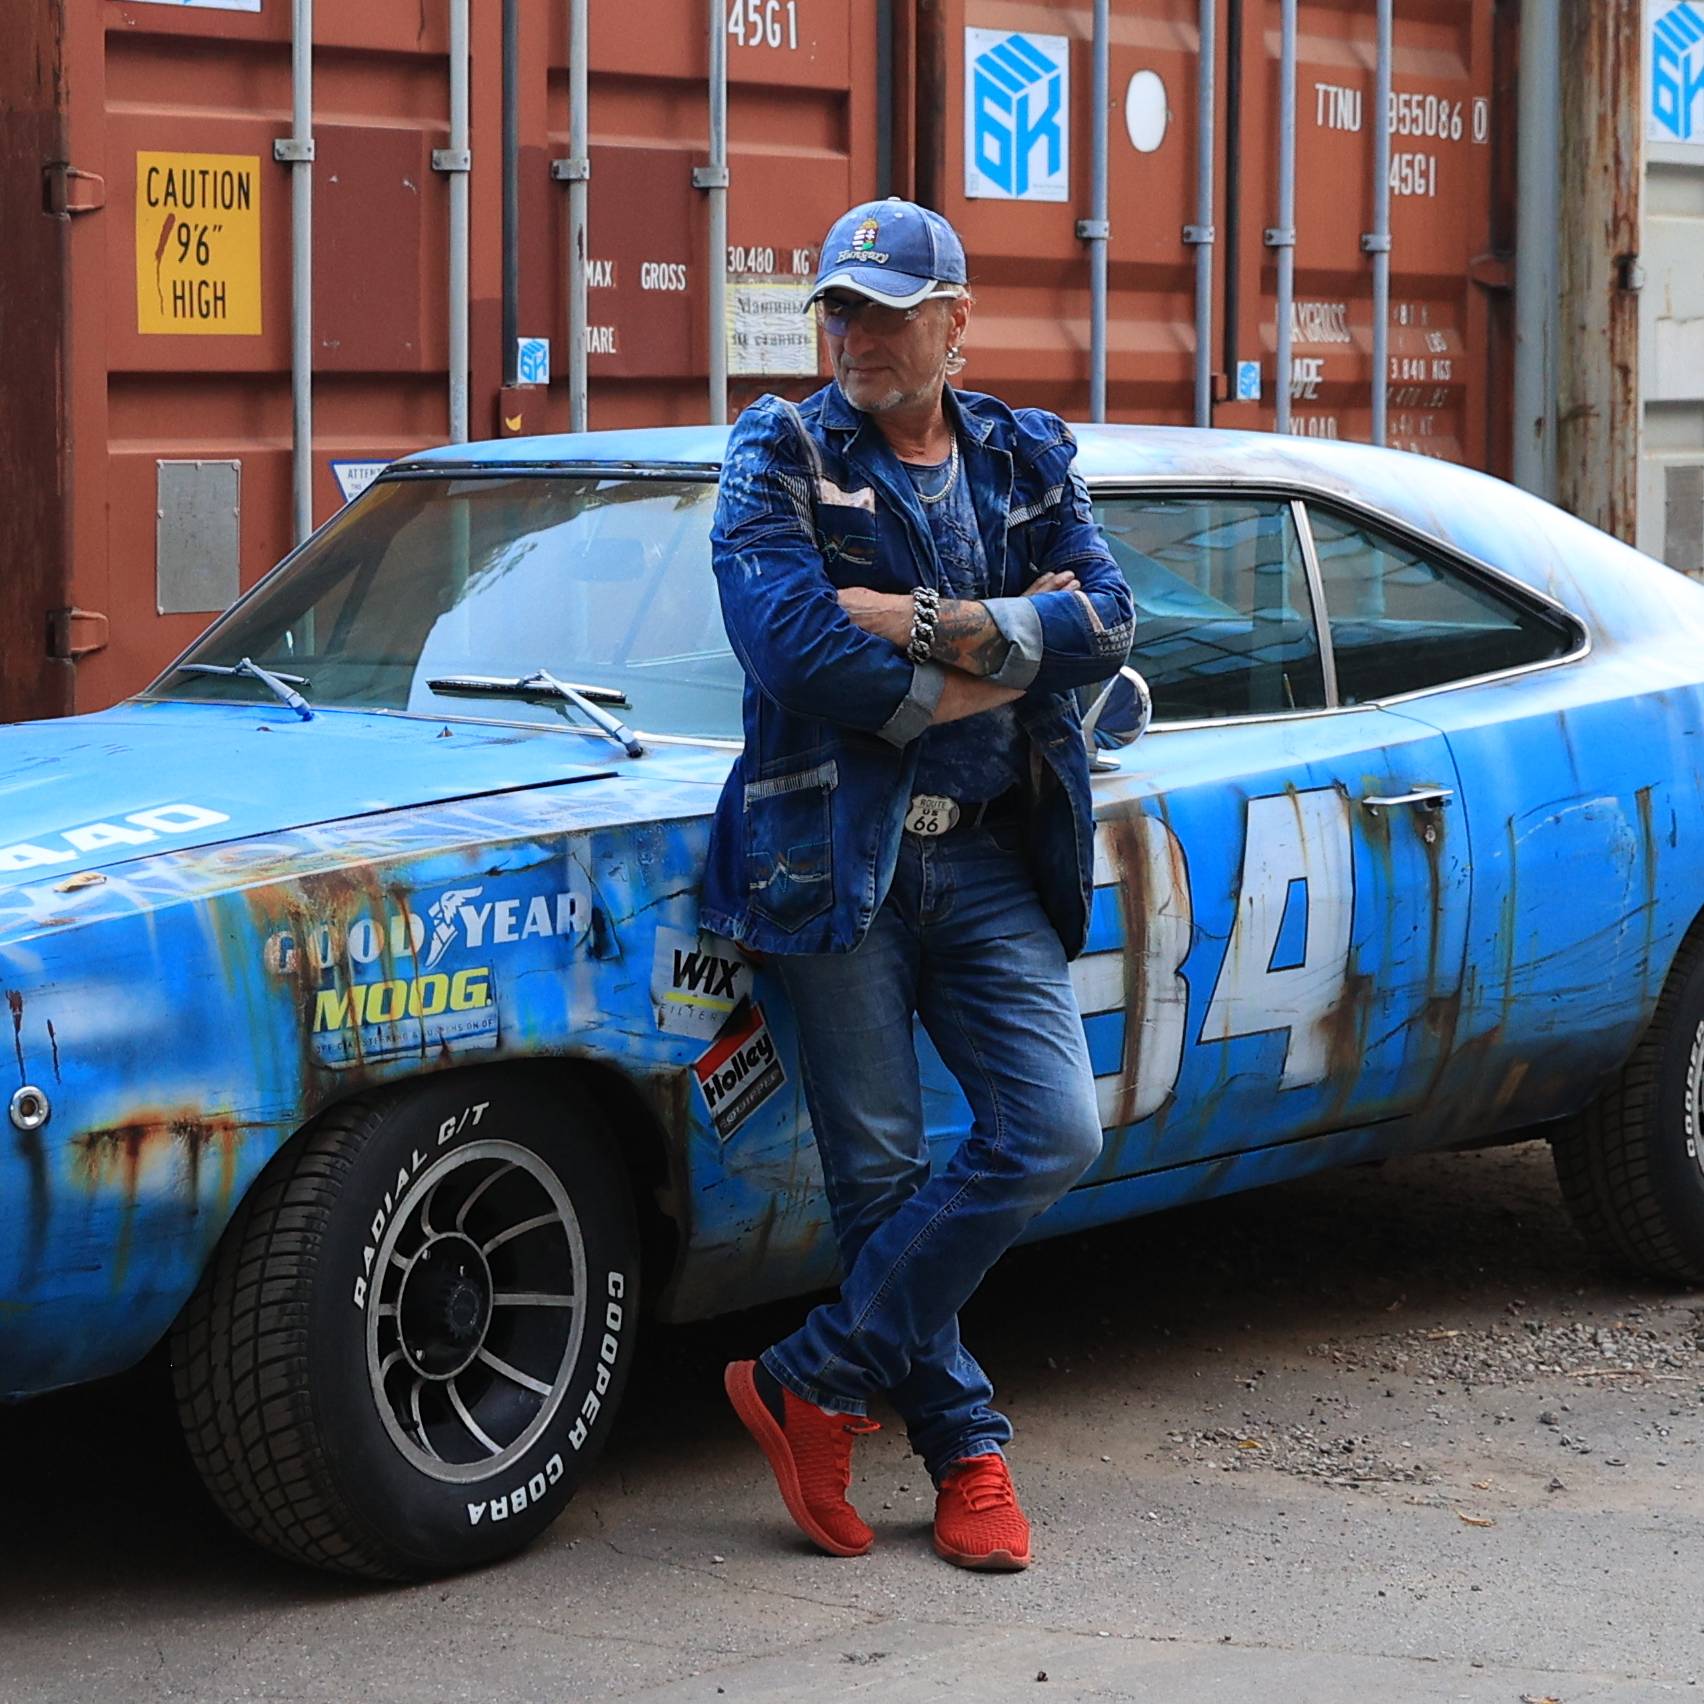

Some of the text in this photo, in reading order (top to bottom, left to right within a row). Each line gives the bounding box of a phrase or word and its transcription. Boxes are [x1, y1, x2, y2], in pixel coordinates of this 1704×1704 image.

[728, 0, 797, 50] 45G1
[1315, 83, 1362, 132] TTNU
[1473, 99, 1488, 141] 0
[146, 166, 251, 210] CAUTION
[641, 262, 687, 291] GROSS
[727, 246, 774, 274] 30.480
[793, 249, 810, 275] KG
[172, 279, 226, 319] HIGH
[585, 326, 616, 353] TARE
[914, 816, 938, 832] 66
[920, 798, 945, 809] ROUTE
[923, 809, 938, 817] US
[673, 949, 741, 999] WIX
[703, 1032, 775, 1108] Holley
[353, 1149, 428, 1310] RADIAL
[437, 1101, 490, 1146] G/T
[466, 1270, 625, 1526] COOPER COBRA
